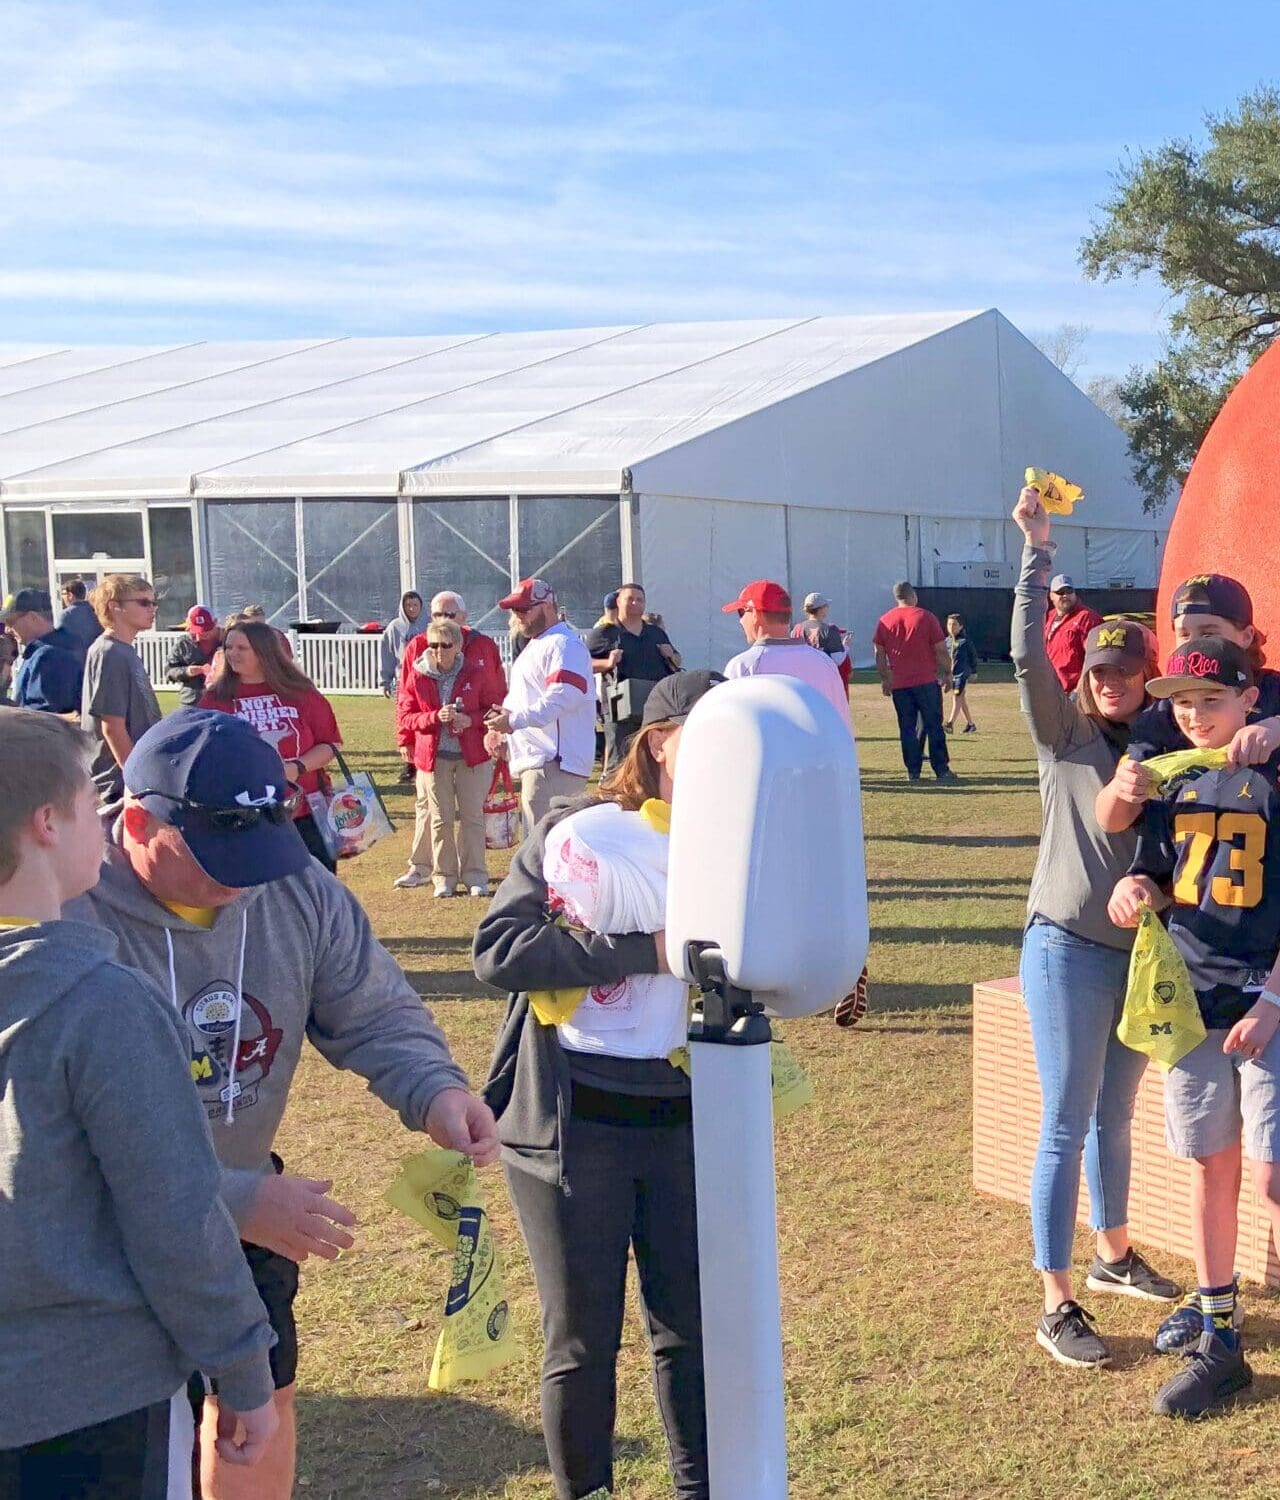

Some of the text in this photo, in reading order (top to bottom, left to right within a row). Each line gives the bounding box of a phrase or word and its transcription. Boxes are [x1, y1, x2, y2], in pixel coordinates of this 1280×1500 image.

[1096, 628, 1127, 648] M
[1187, 651, 1219, 677] Rica
[240, 697, 275, 710] NOT
[1174, 812, 1268, 908] 73
[1149, 1022, 1173, 1036] M
[190, 1055, 213, 1081] M
